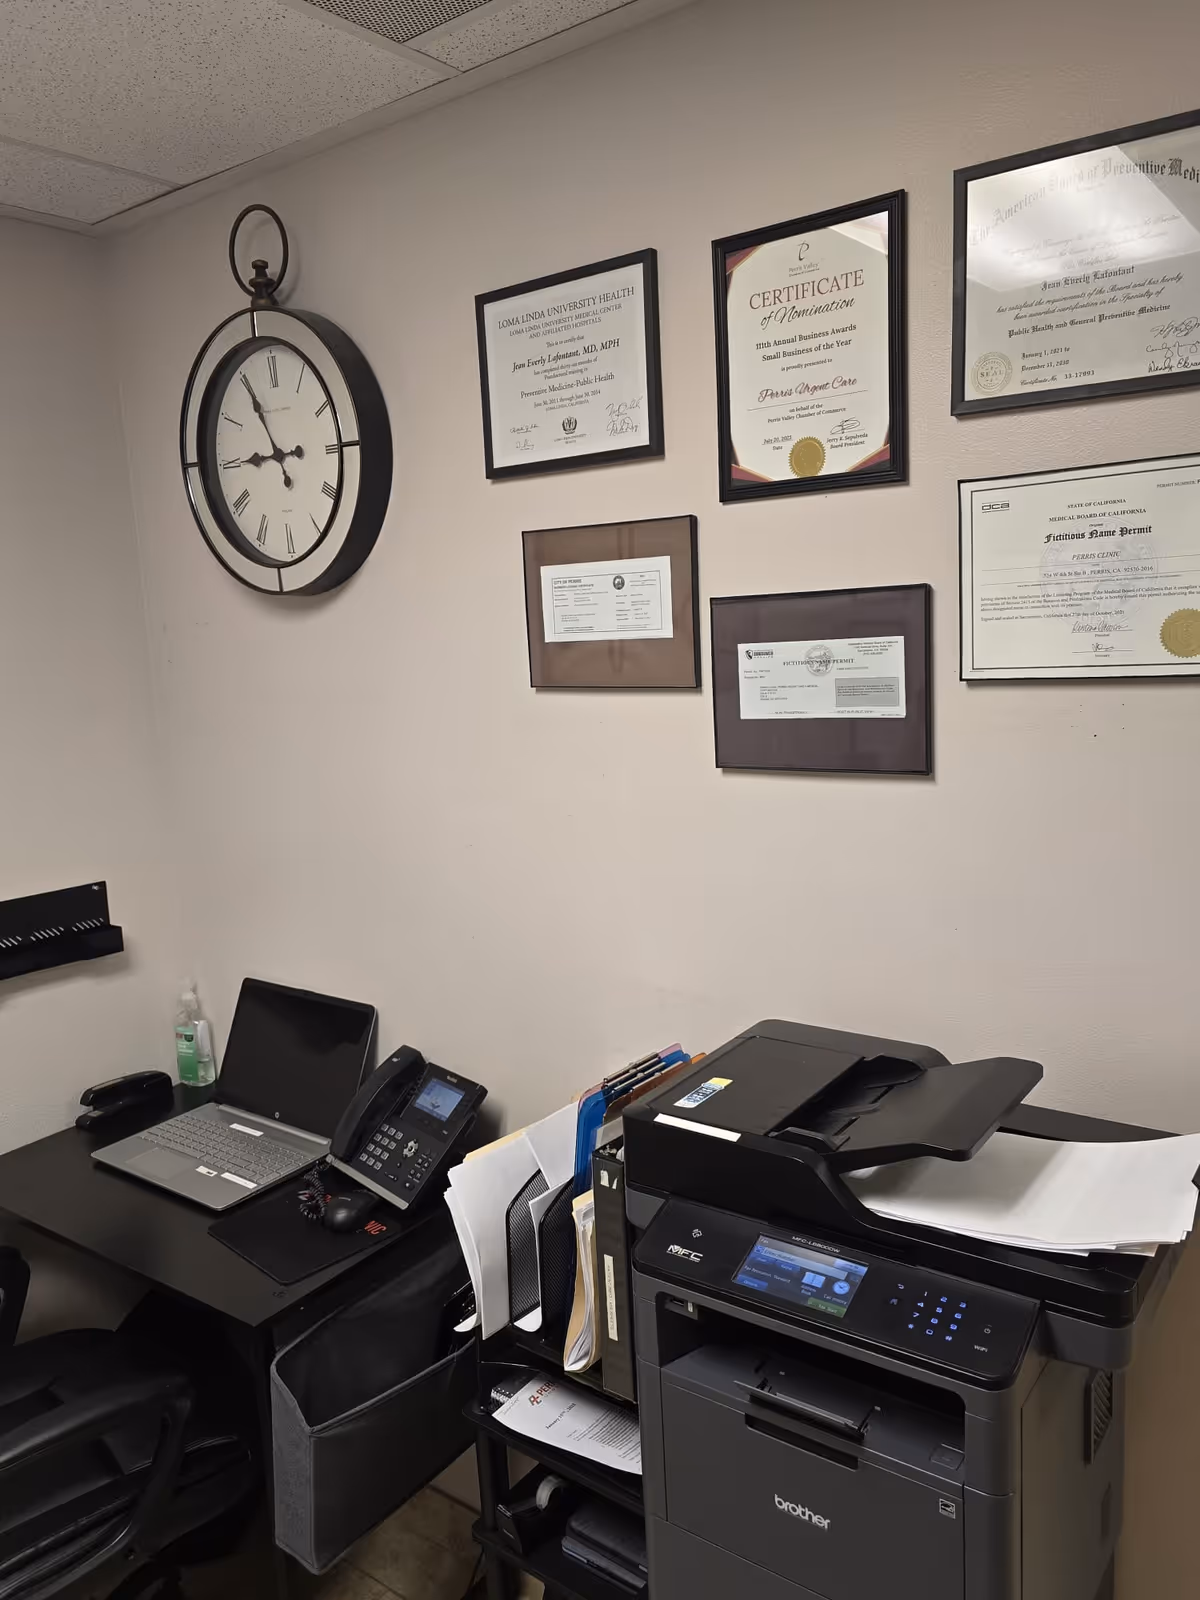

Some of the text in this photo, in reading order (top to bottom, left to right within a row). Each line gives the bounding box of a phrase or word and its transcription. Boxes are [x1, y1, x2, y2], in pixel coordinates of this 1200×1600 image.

[1101, 156, 1166, 178] Preventive
[749, 269, 864, 310] CERTIFICATE
[498, 286, 634, 330] LOMA LINDA UNIVERSITY HEALTH
[760, 297, 855, 330] of Nomination
[1008, 304, 1171, 338] Public Health and General Preventive Medicine
[773, 335, 797, 347] Annual
[798, 329, 829, 342] Business
[831, 323, 856, 336] Awards
[512, 338, 620, 373] Jean Everly Lafontant, MD, MPH
[762, 338, 852, 362] Small Business of the Year
[520, 372, 614, 399] Preventive Medicine-Public Health
[758, 376, 858, 403] Perris Urgent Care
[1092, 498, 1127, 507] CALIFORNIA
[1108, 508, 1147, 517] CALIFORNIA
[1043, 524, 1152, 543] Fictitious Name Permit
[1072, 550, 1122, 561] PERRIS CLINIC
[668, 1244, 703, 1261] MFC
[775, 1493, 831, 1530] brother
